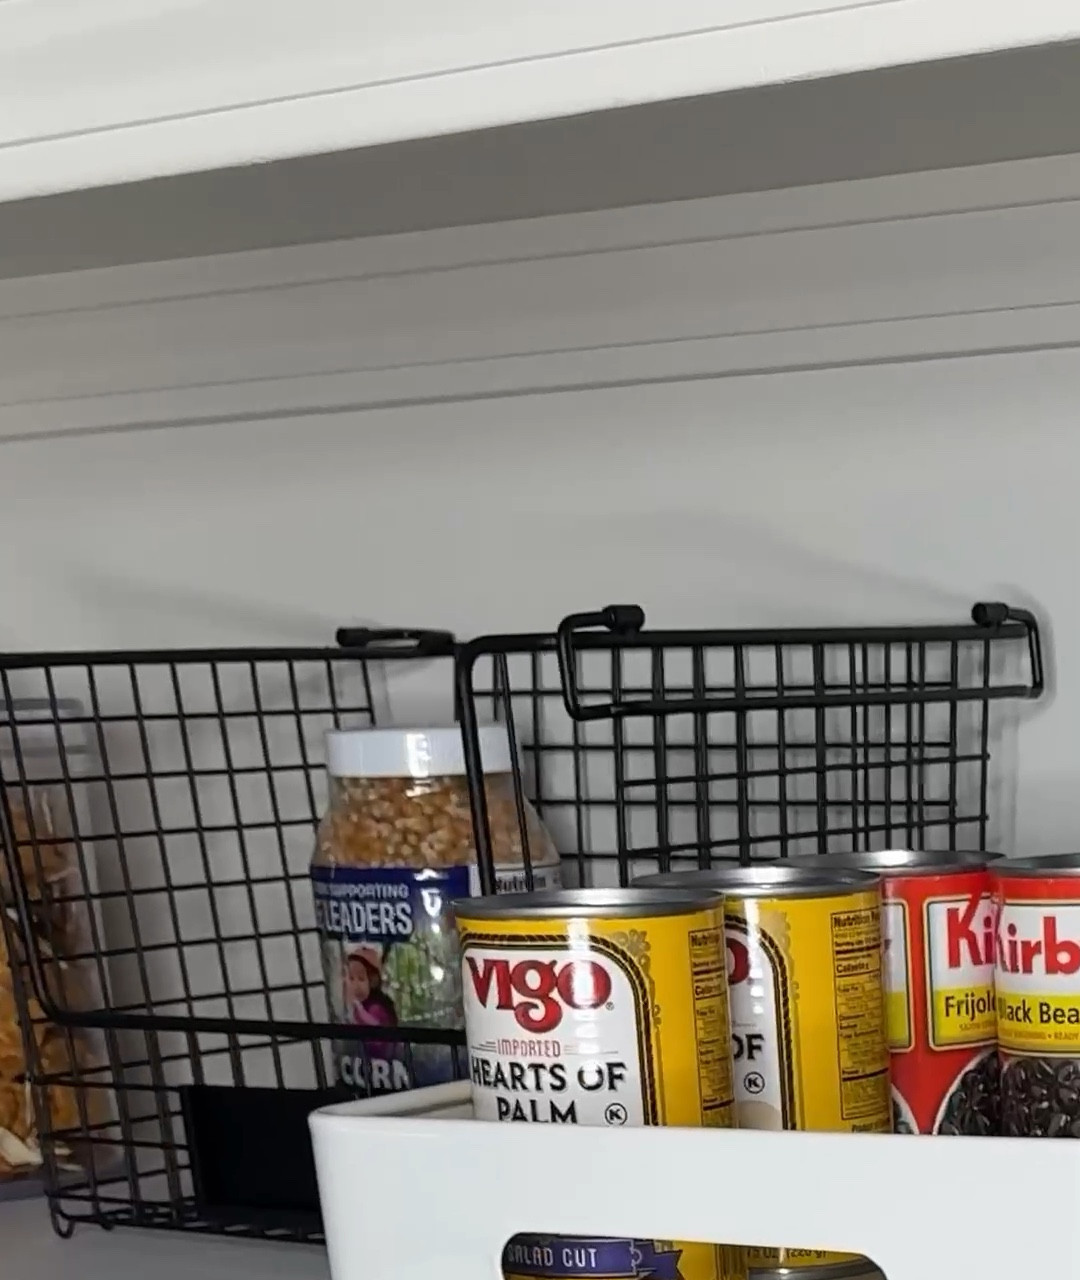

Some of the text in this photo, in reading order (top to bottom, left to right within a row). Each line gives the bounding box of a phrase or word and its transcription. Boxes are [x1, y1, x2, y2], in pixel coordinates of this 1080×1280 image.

[326, 901, 414, 936] LEADERS
[495, 1038, 562, 1058] IMPORTED
[470, 1057, 629, 1092] HEARTS OF
[496, 1096, 578, 1124] PALM
[563, 1247, 598, 1268] CUT
